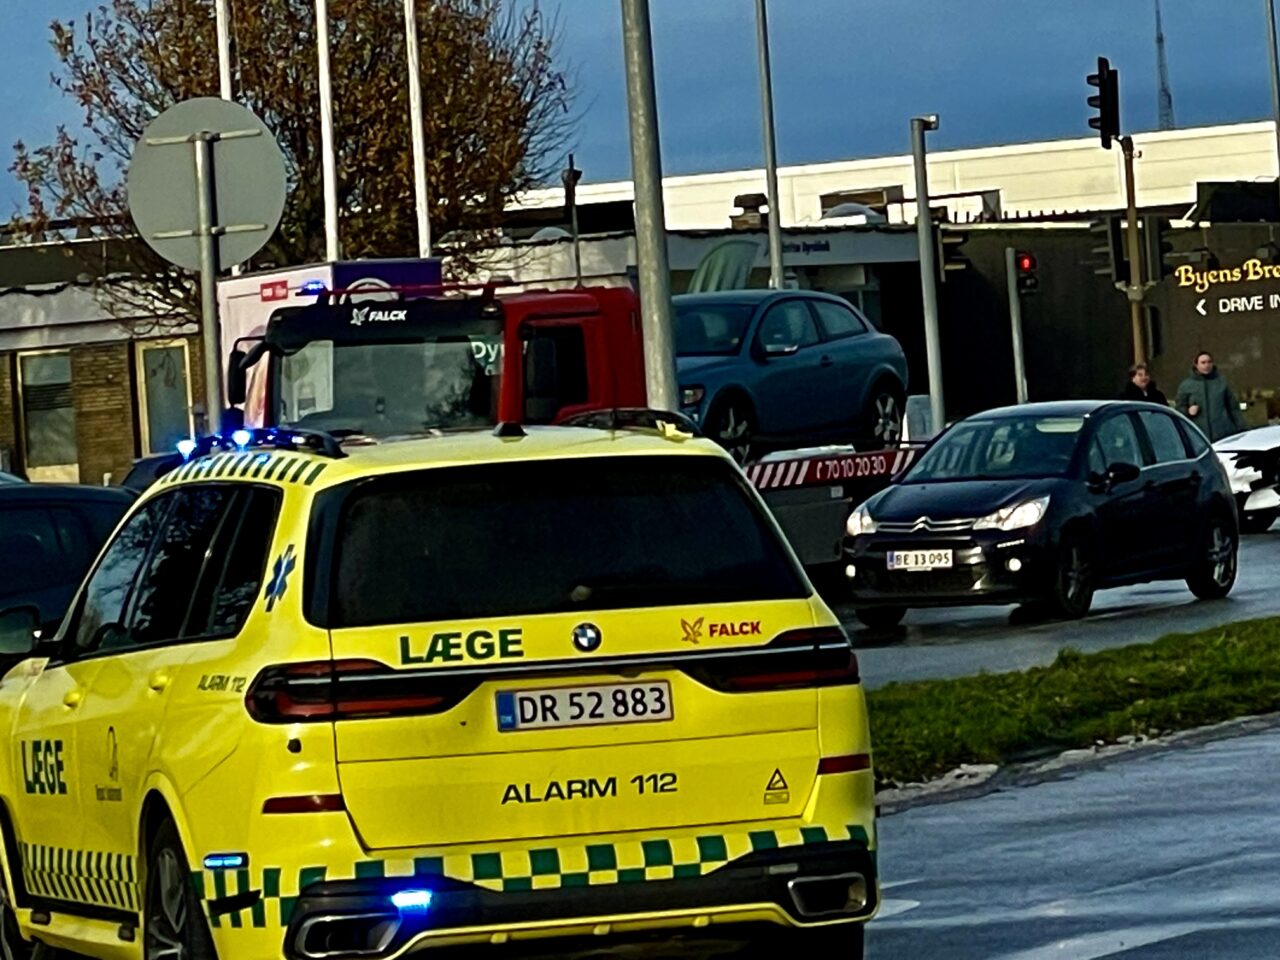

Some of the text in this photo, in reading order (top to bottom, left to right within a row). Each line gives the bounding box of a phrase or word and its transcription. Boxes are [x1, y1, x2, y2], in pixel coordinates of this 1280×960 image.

[1175, 264, 1242, 293] Byens
[368, 309, 408, 322] FALCK
[1218, 295, 1264, 313] DRIVE
[825, 455, 887, 479] 70 10 20 30
[914, 553, 927, 566] 13
[708, 620, 762, 638] FALCK
[399, 628, 525, 665] LÆGE
[518, 687, 666, 725] DR 52 883
[21, 739, 68, 795] LÆGE
[501, 772, 679, 805] ALARM 112
